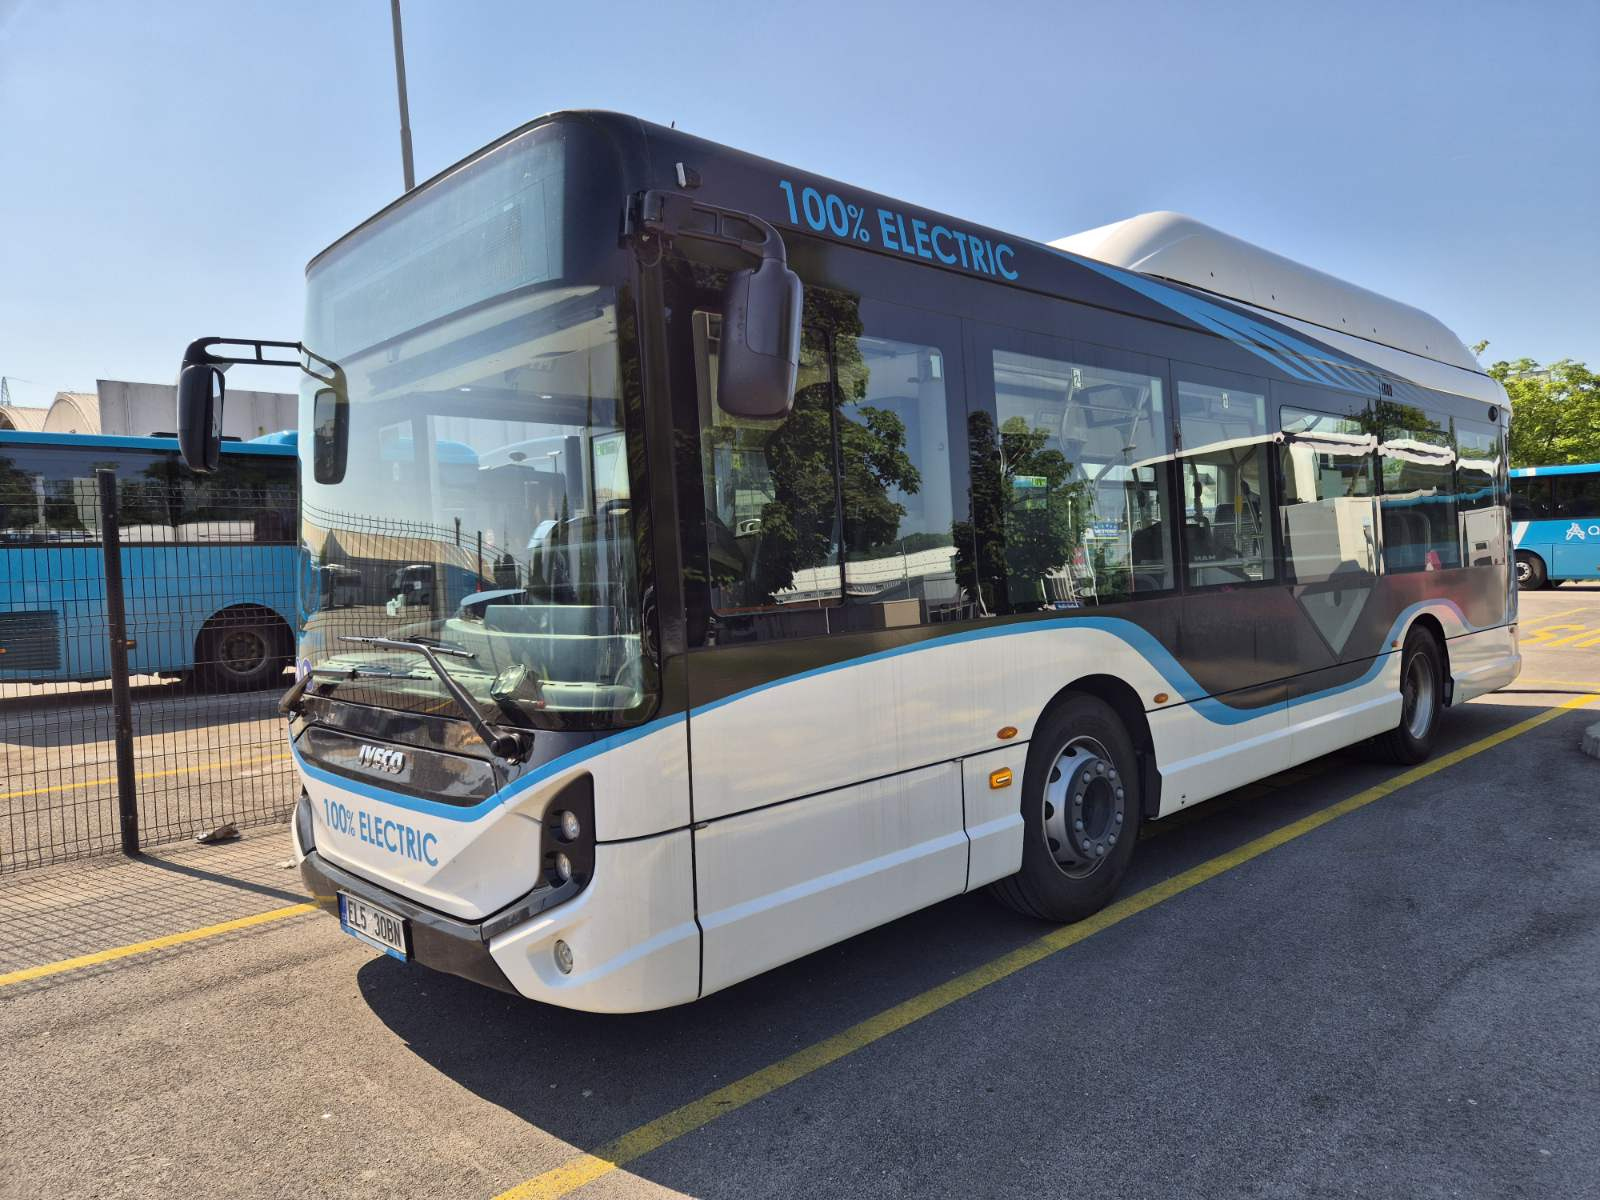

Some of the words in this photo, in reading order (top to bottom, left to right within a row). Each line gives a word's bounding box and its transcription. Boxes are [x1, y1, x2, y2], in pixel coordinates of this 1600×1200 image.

[779, 180, 870, 243] 100%
[877, 207, 1019, 281] ELECTRIC
[359, 744, 406, 775] IVECO
[323, 798, 356, 837] 100%
[359, 811, 439, 867] ELECTRIC
[348, 900, 367, 929] EL5
[373, 912, 402, 948] 30BN
